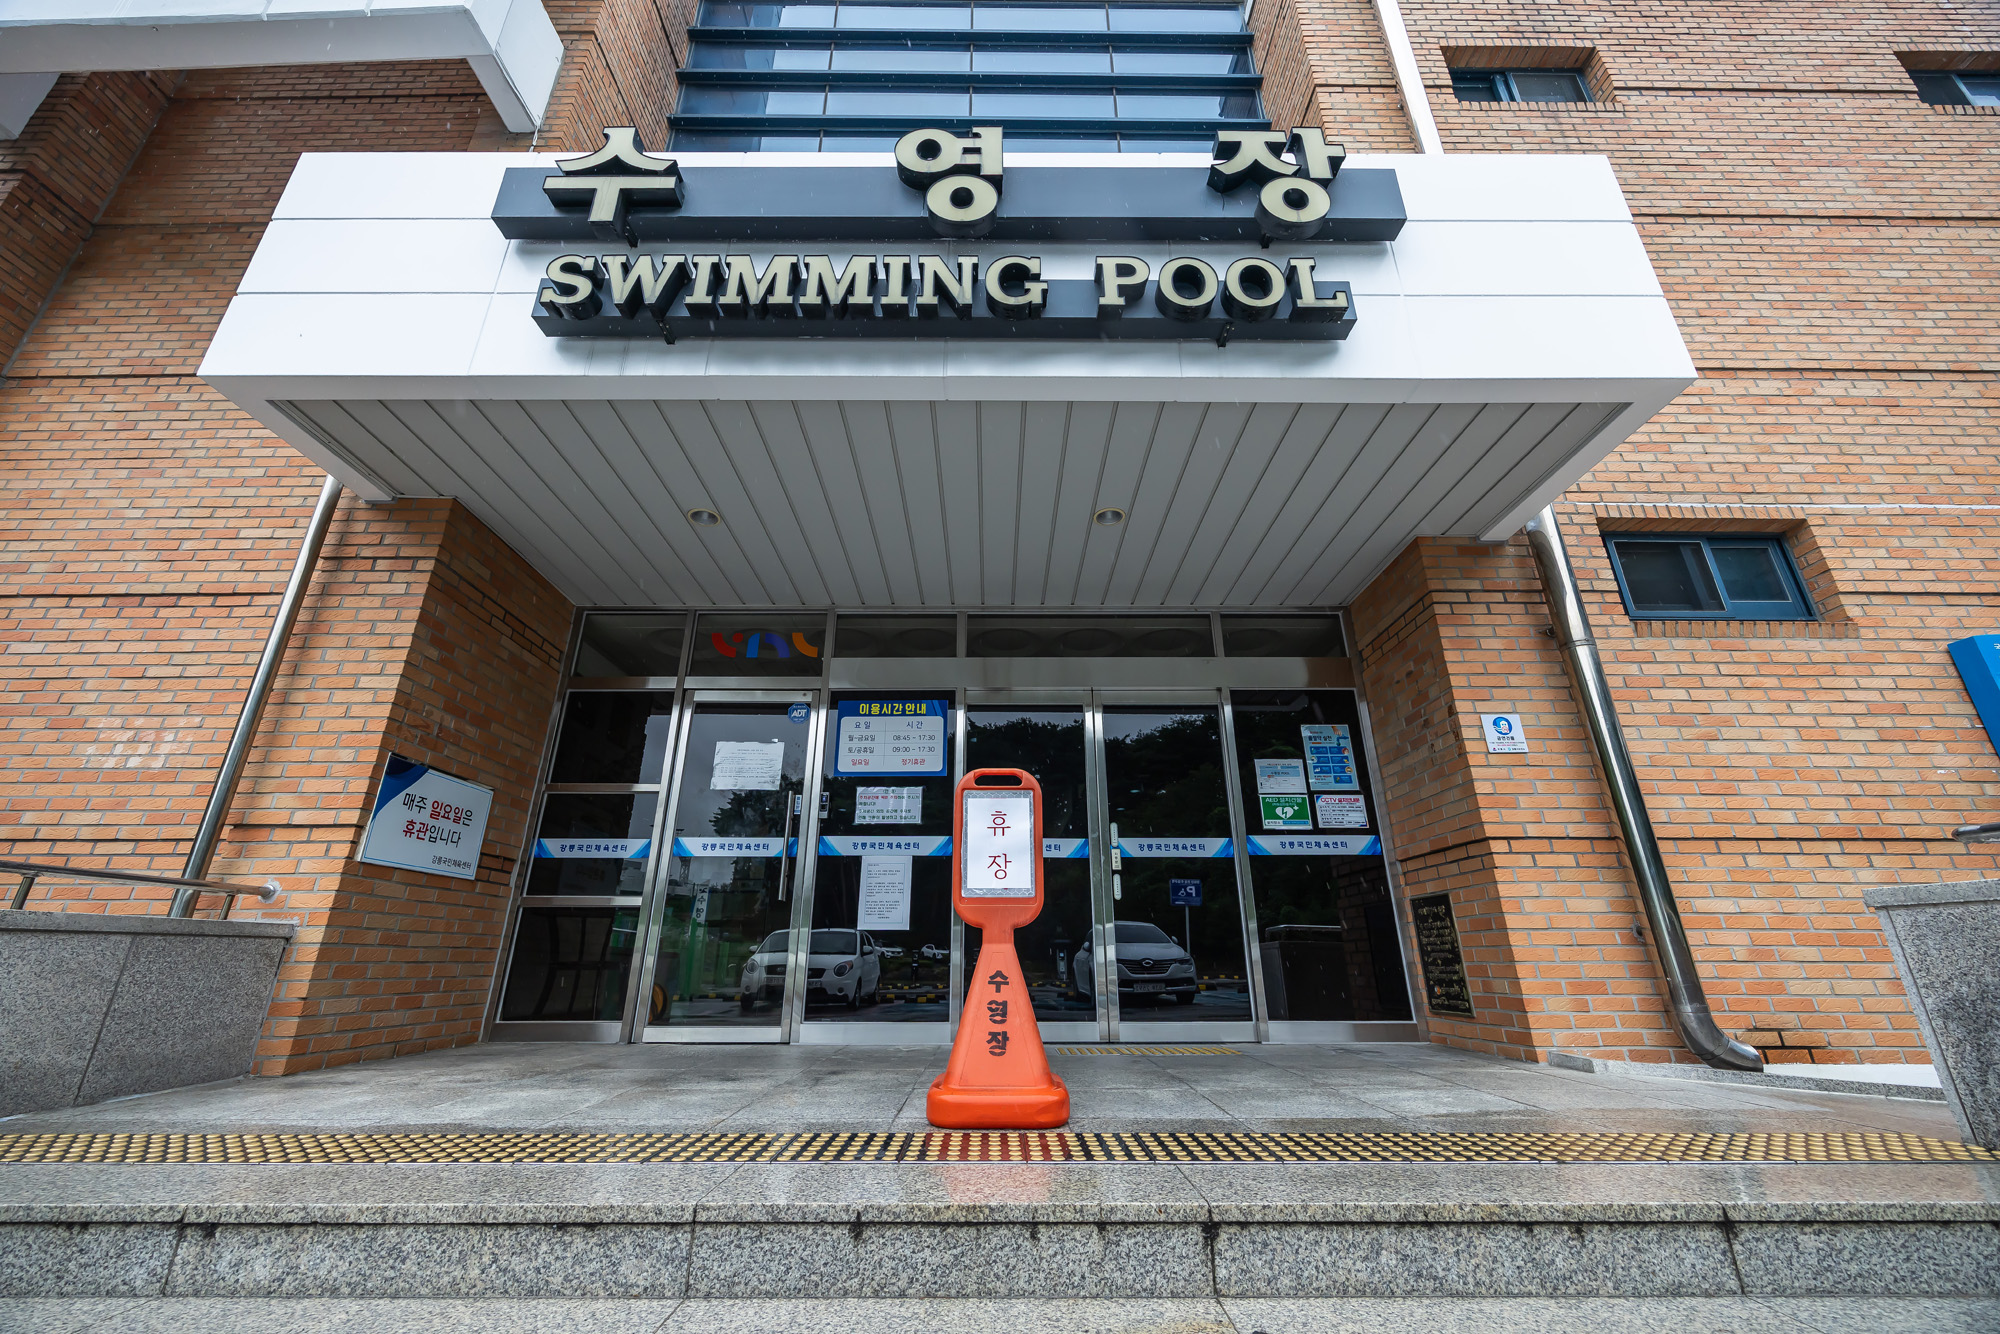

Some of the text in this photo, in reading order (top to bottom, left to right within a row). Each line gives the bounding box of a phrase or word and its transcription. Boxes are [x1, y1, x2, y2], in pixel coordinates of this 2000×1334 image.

[539, 253, 1350, 308] SWIMMING POOL
[791, 709, 807, 718] ADT
[859, 703, 927, 715] 이용시간 안내
[850, 758, 870, 766] 일요일
[901, 758, 926, 766] 정기휴관
[402, 792, 473, 827] 매주 일요일은
[402, 819, 462, 848] 휴관입니다
[559, 844, 628, 853] 강릉국민체육센터
[701, 842, 770, 851] 강릉국민체육센터
[852, 841, 920, 850] 강릉국민체육센터
[1137, 843, 1206, 852] 강릉국민체육센터
[1279, 840, 1348, 849] 강릉국민체육센터
[431, 855, 472, 871] 강릉국민체육센터
[986, 970, 1010, 1057] 수영장
